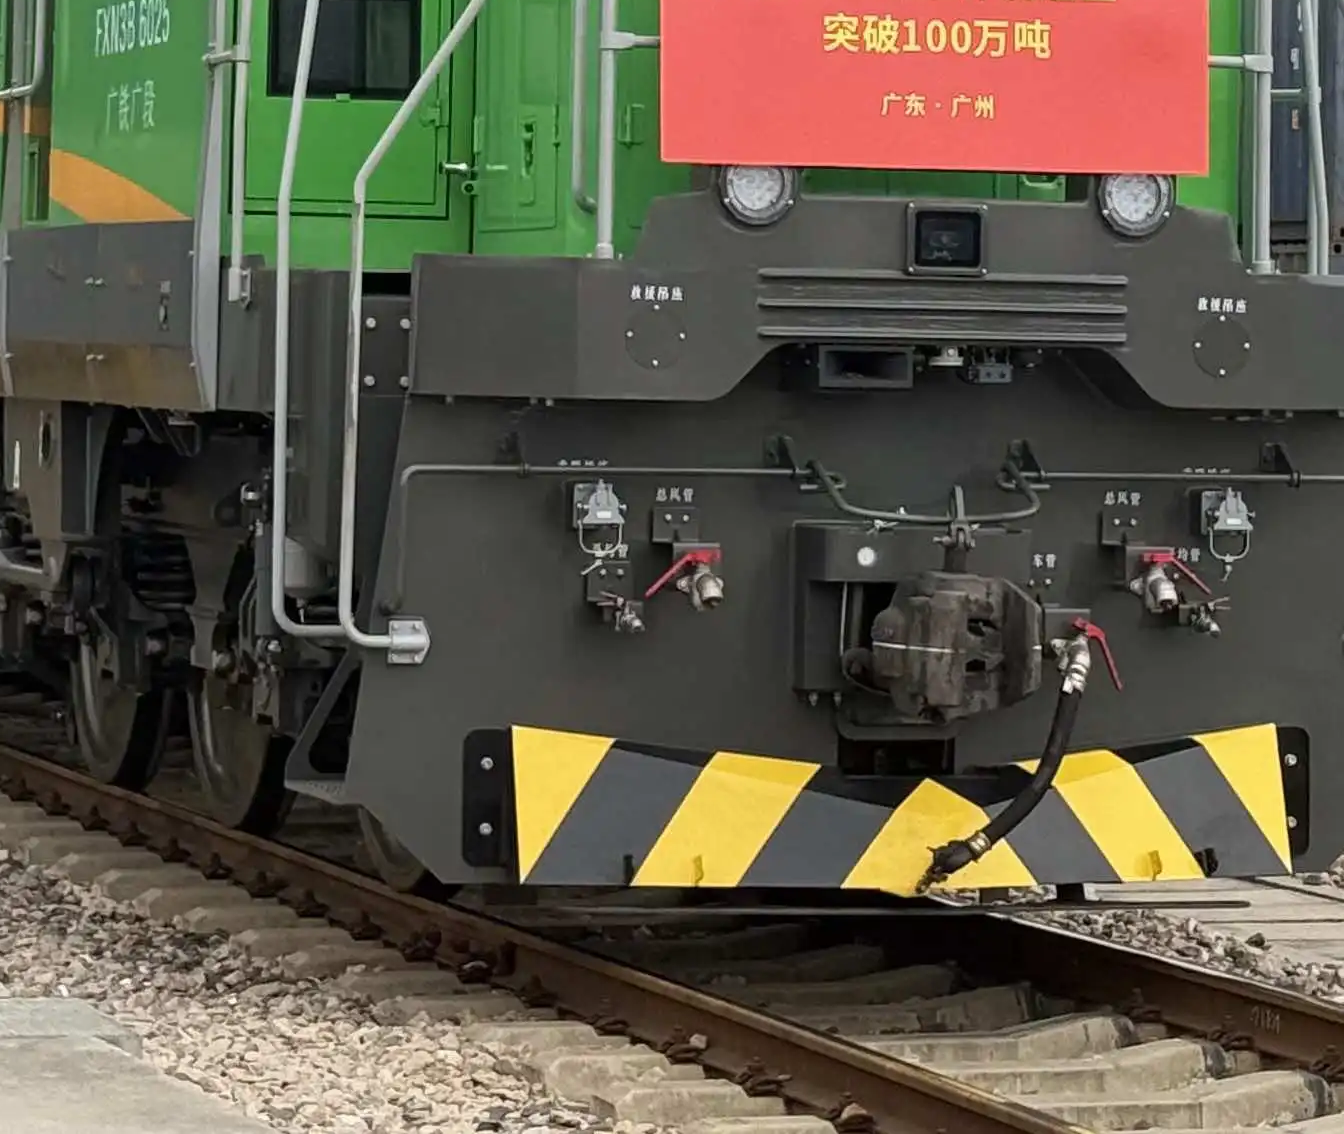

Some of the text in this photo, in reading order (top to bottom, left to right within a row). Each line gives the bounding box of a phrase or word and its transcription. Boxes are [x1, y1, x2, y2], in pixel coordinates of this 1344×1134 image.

[95, 0, 136, 57] FXN3B
[823, 13, 1053, 59] 突破100万吨
